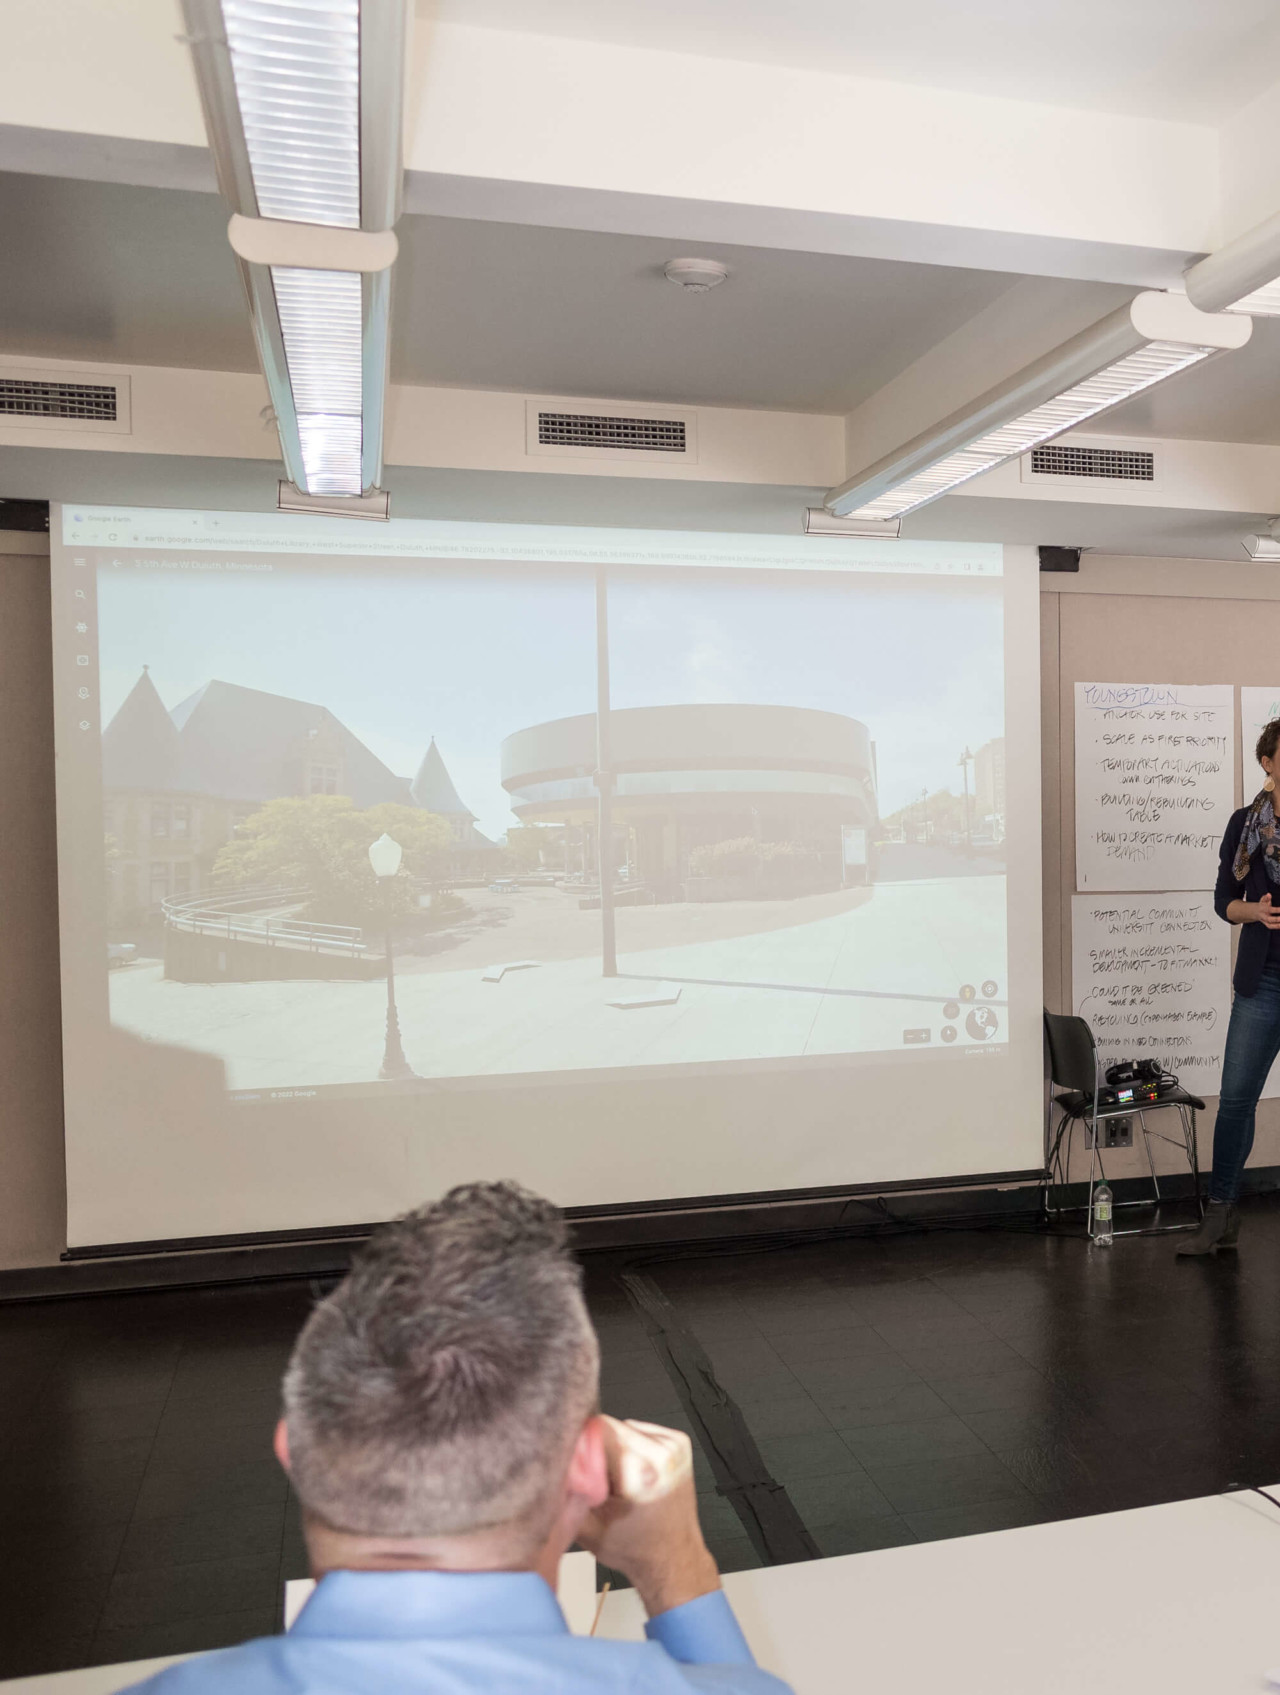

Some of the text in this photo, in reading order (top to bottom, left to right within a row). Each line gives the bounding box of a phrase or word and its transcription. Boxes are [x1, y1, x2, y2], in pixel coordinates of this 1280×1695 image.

[1084, 685, 1178, 705] YOUNGSTOWN
[1148, 710, 1166, 721] USE
[1171, 710, 1188, 721] FOR
[1193, 711, 1217, 722] SITE
[1102, 733, 1136, 746] SCALE
[1141, 734, 1155, 744] AS
[1096, 830, 1116, 844] HOW
[1174, 833, 1222, 850] MARKET
[1107, 846, 1155, 862] DEMAND
[1093, 909, 1145, 923] POTENTIAL
